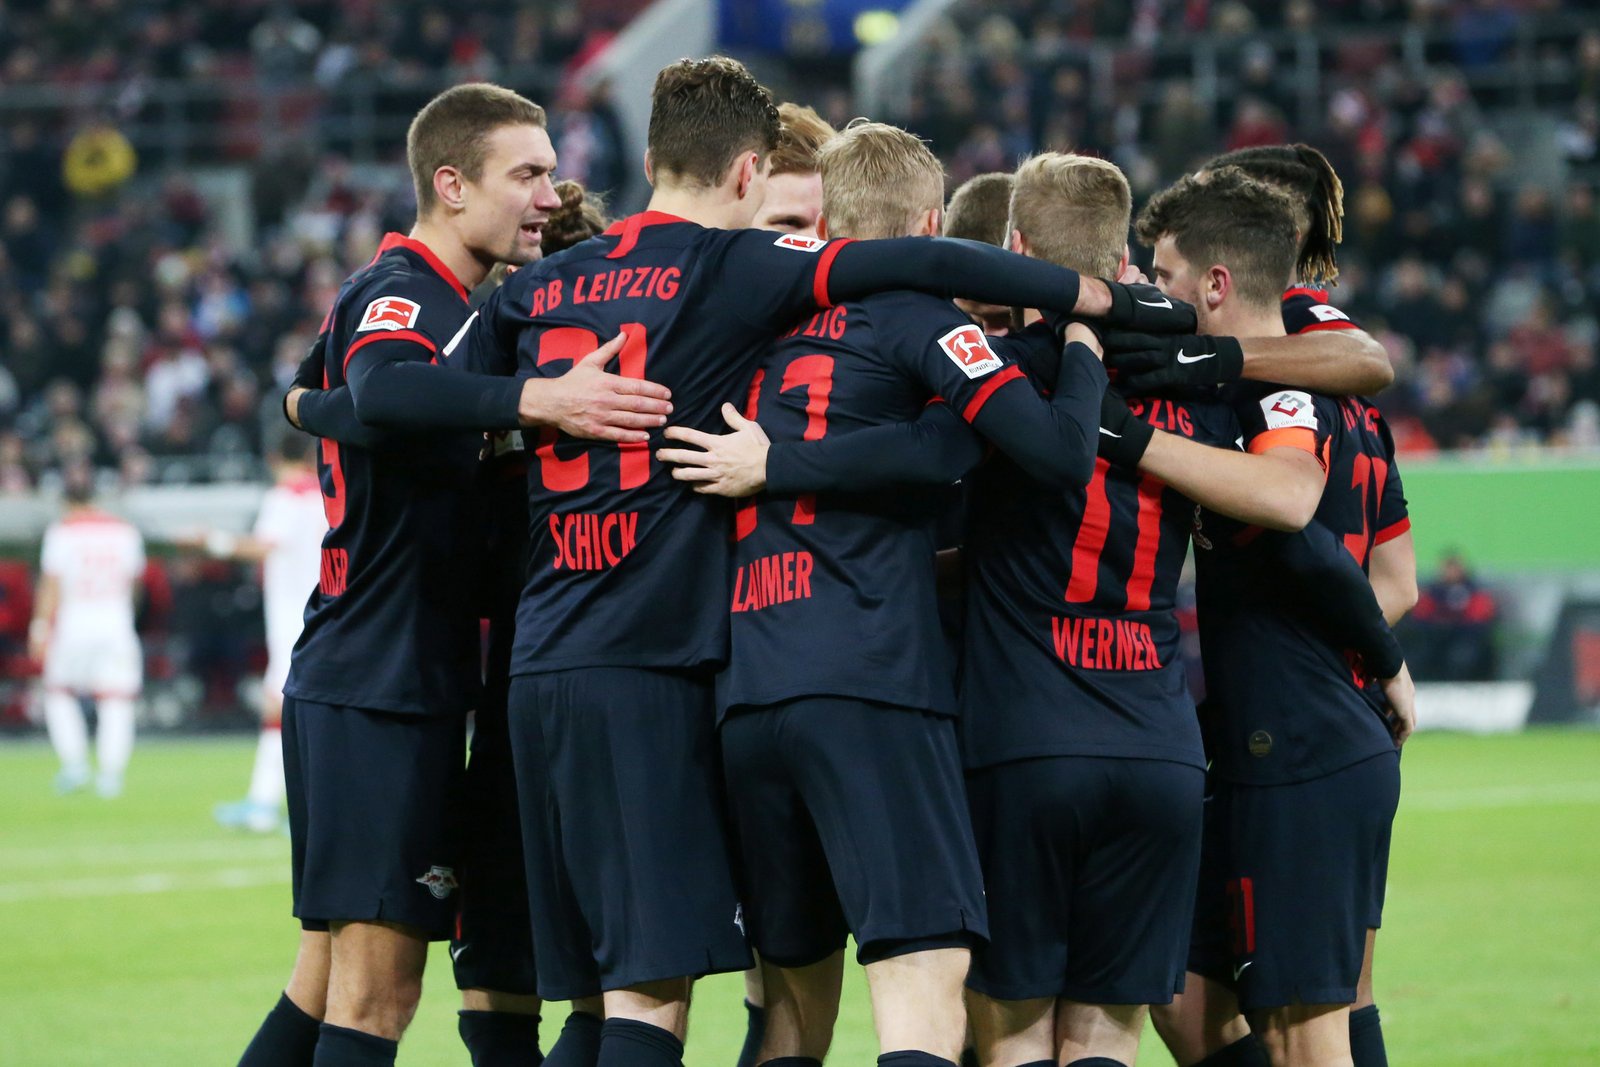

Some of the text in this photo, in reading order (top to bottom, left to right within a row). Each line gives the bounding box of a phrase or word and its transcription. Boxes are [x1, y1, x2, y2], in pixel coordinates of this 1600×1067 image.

[530, 267, 681, 317] RB LEIPZIG
[549, 512, 639, 571] SCHICK
[1065, 456, 1167, 611] 11
[731, 551, 814, 613] LAIMER
[1051, 616, 1163, 671] WERNER
